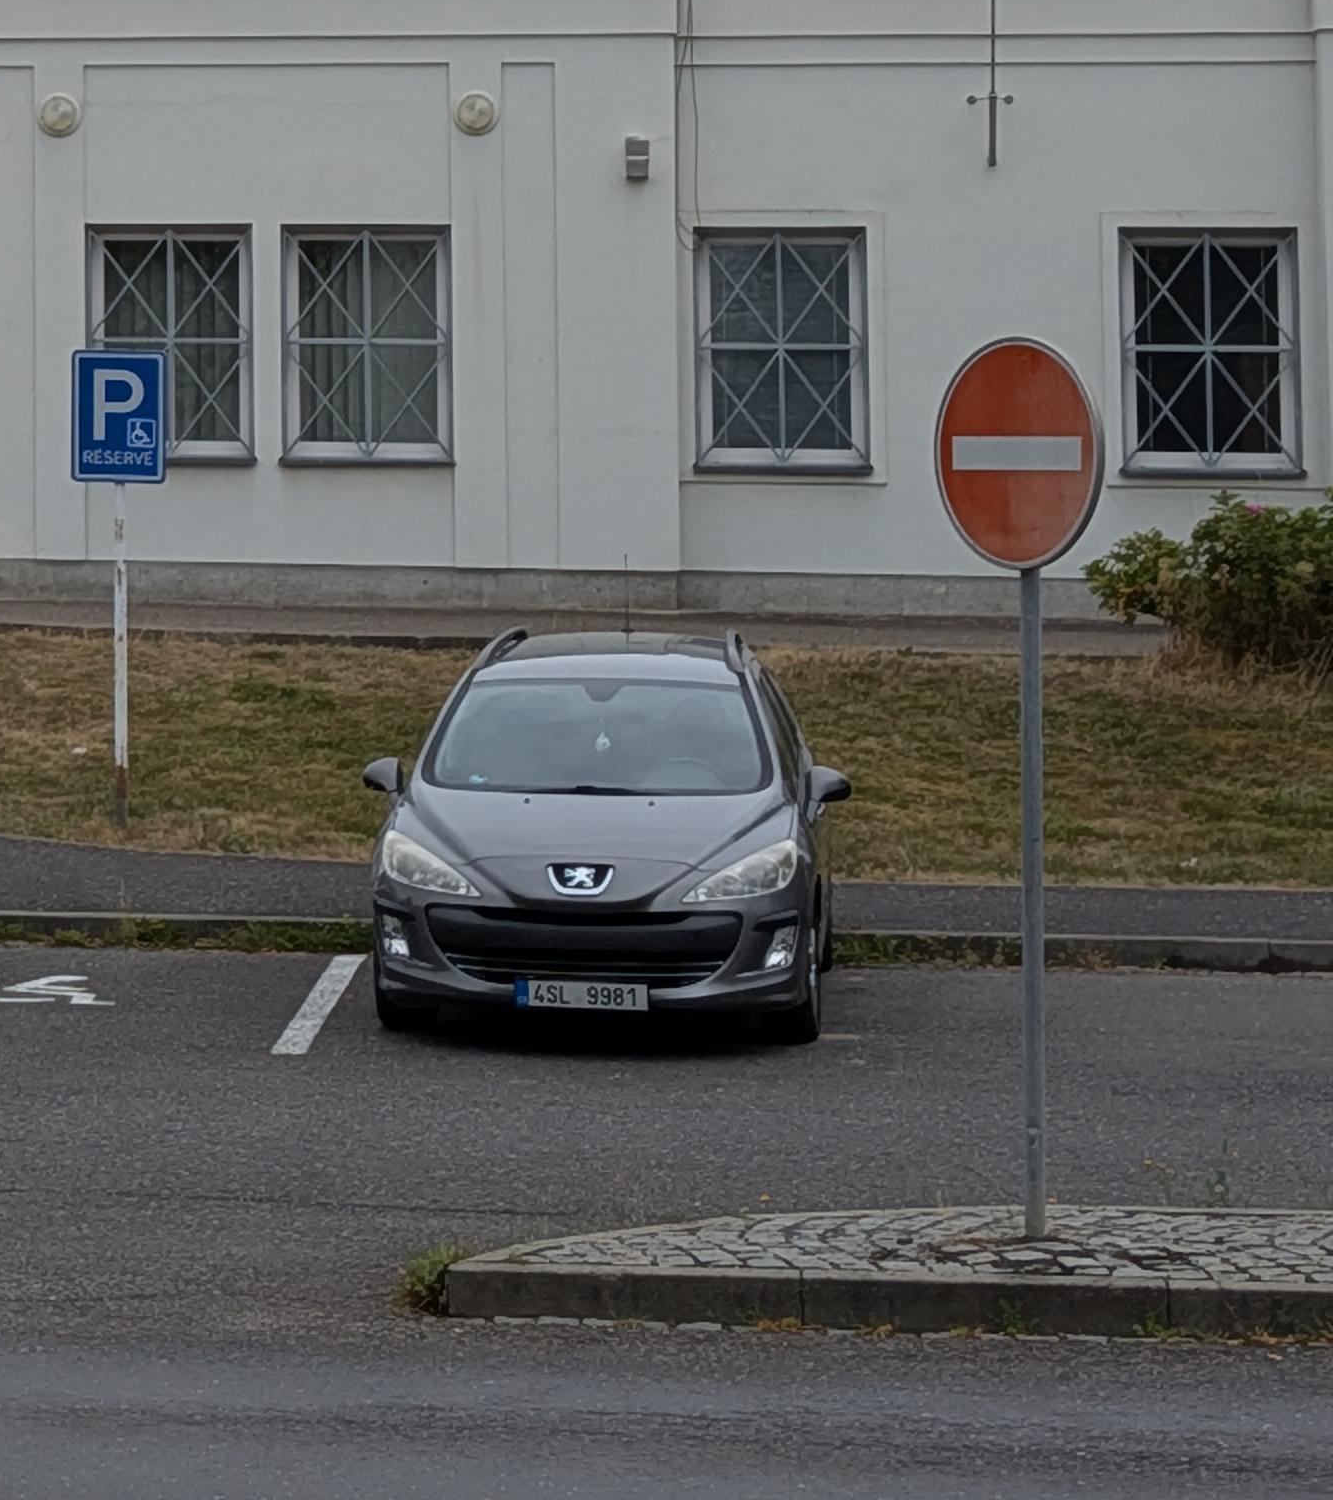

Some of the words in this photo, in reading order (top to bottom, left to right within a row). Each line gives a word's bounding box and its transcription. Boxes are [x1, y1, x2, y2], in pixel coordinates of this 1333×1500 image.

[93, 368, 145, 441] P
[533, 984, 571, 1005] 4SL
[586, 985, 637, 1007] 9981
